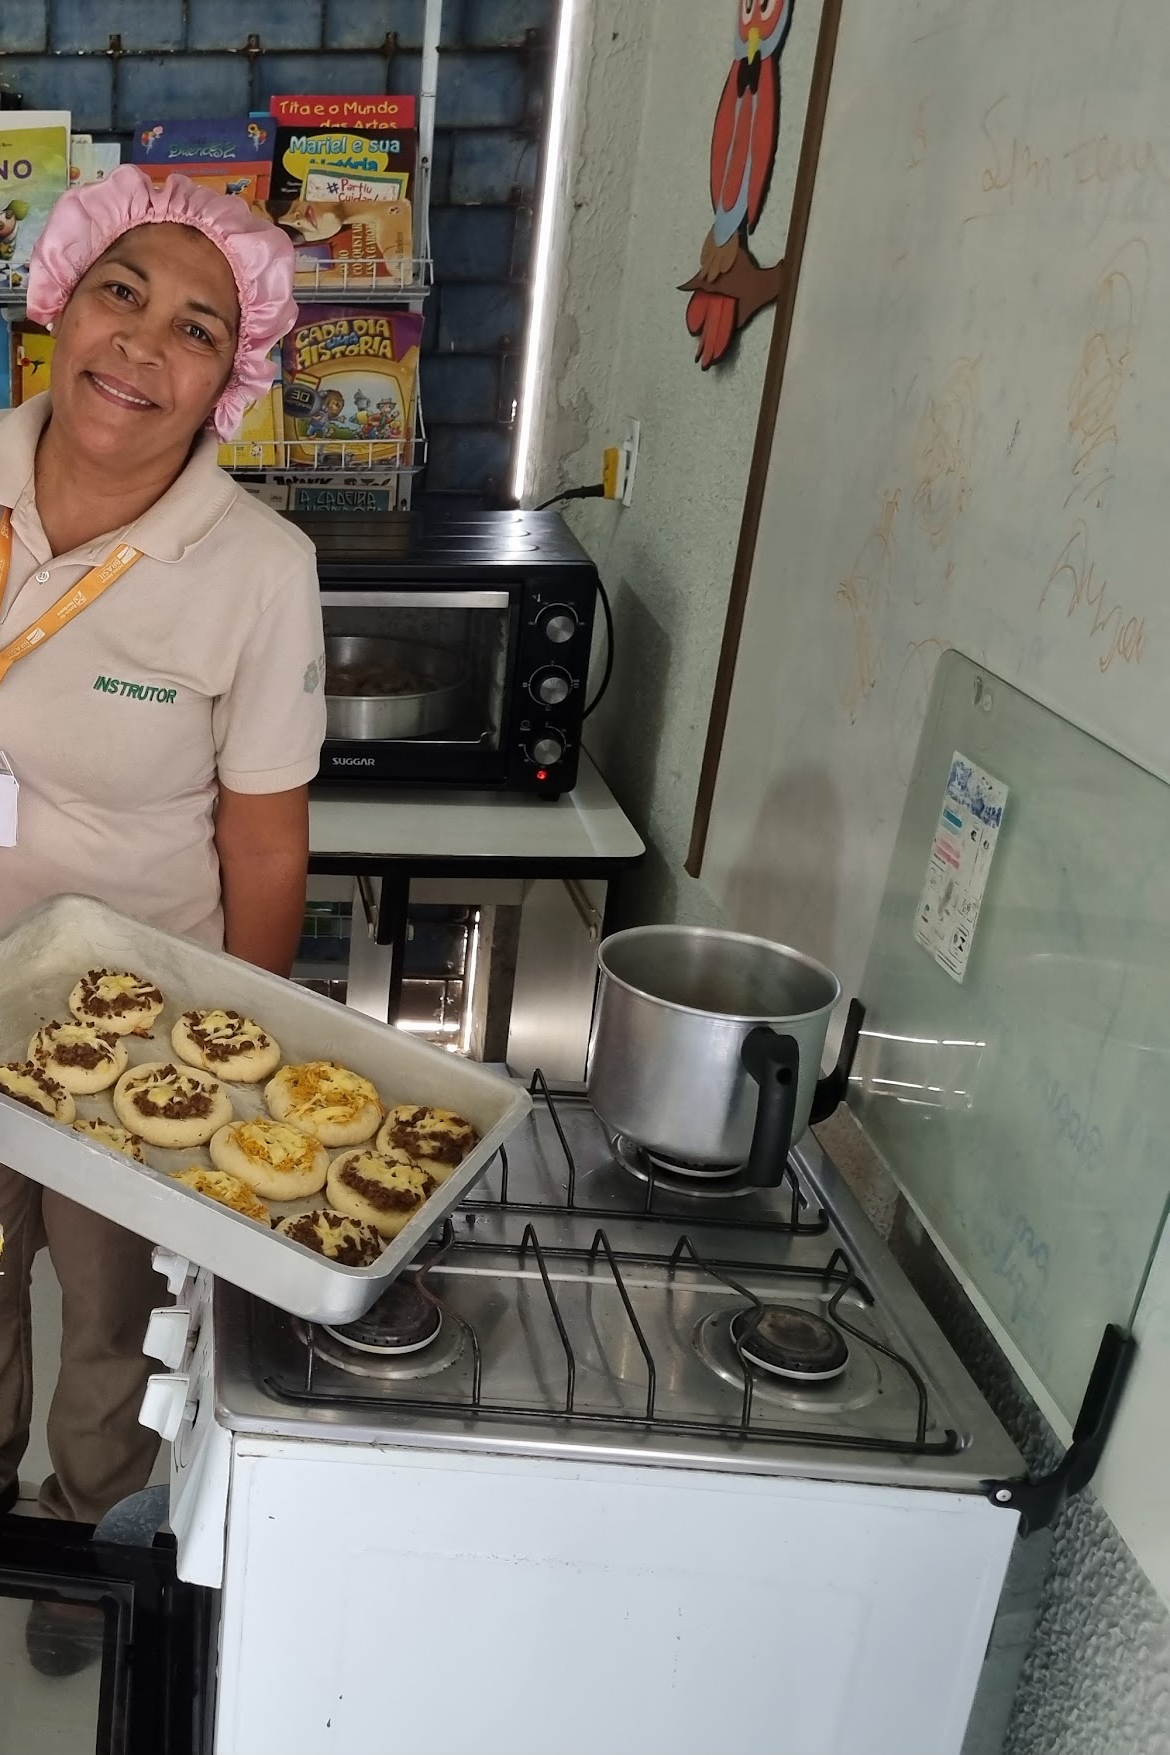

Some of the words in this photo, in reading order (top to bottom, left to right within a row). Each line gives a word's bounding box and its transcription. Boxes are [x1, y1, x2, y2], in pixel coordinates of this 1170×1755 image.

[280, 101, 310, 115] Tita
[314, 105, 324, 115] e
[344, 101, 399, 116] Mundo
[289, 135, 348, 155] Mariel
[352, 139, 363, 153] e
[369, 138, 401, 154] sua
[351, 223, 365, 275] COQUISTAR
[296, 320, 349, 349] CADA
[353, 319, 390, 338] DIA
[290, 389, 310, 403] 30
[317, 491, 377, 507] CADEIRA
[93, 675, 178, 704] INSTRUTOR
[332, 757, 375, 767] SUGGAR
